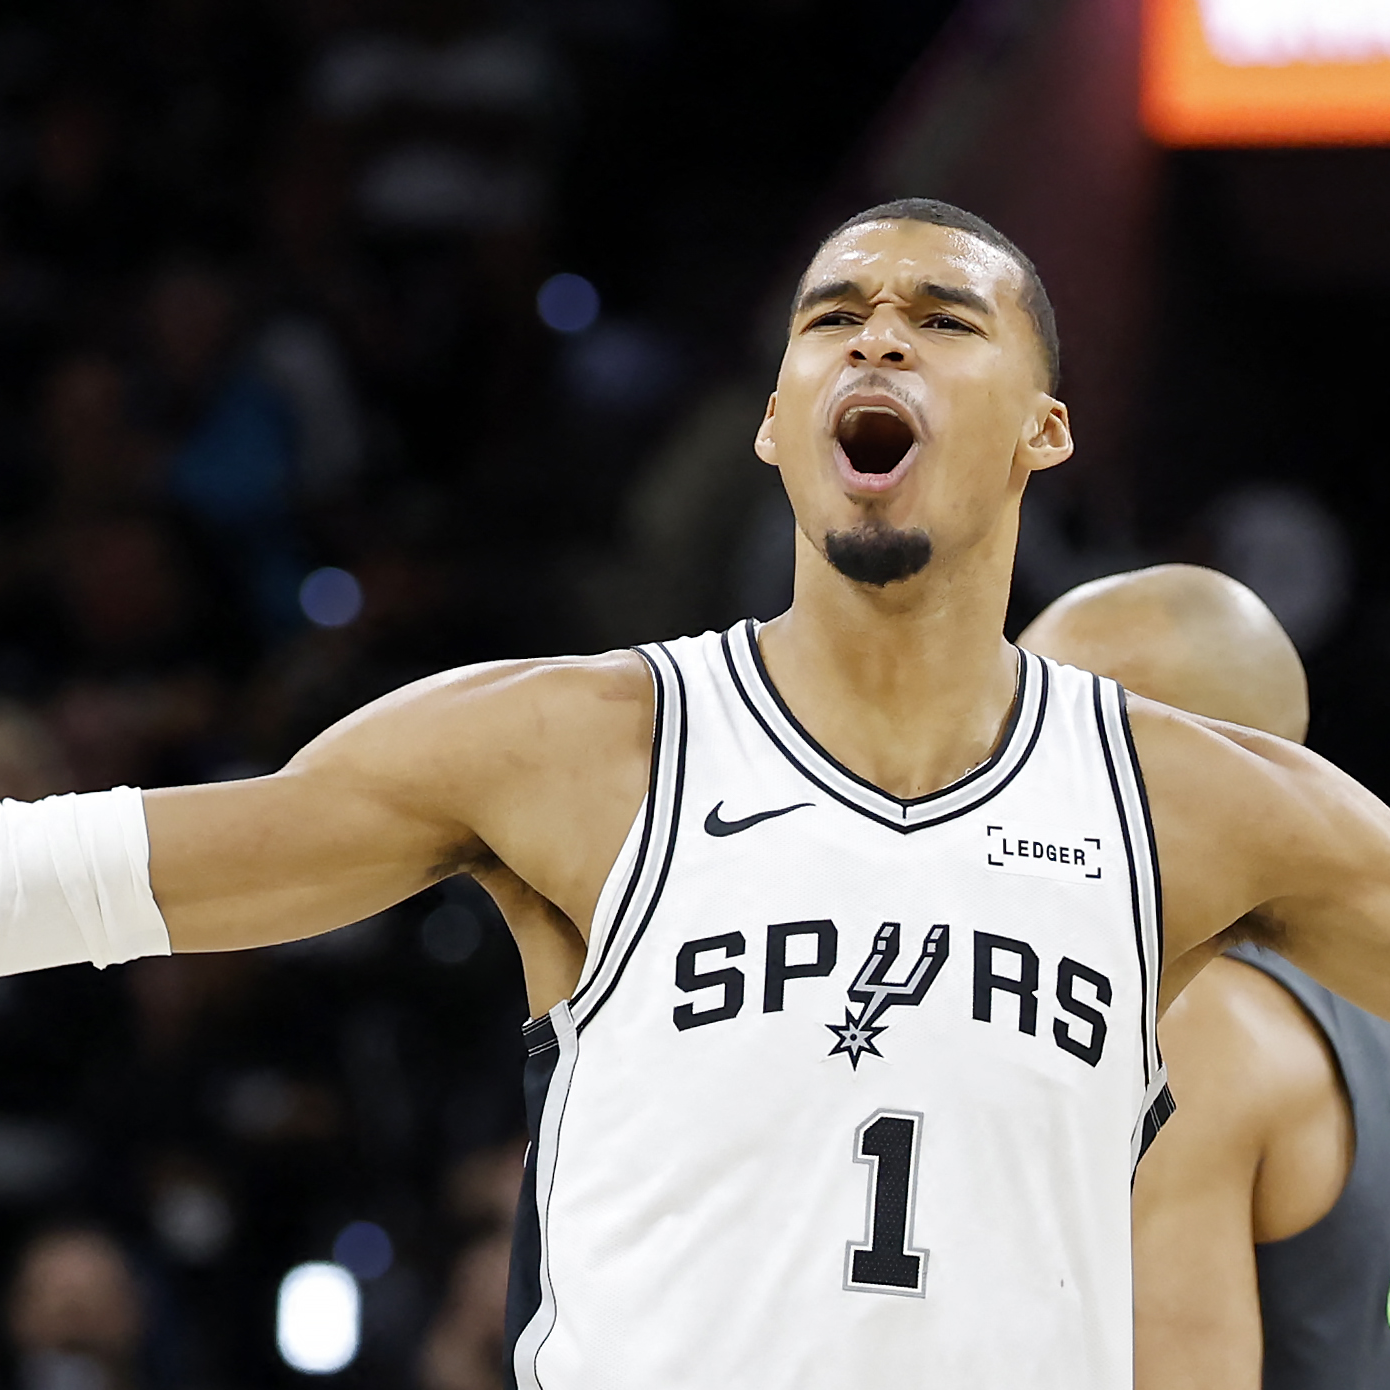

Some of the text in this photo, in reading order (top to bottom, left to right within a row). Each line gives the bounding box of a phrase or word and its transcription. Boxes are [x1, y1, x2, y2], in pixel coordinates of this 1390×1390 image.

[1002, 838, 1086, 866] LEDGER
[672, 918, 1113, 1071] SPURS
[842, 1108, 930, 1298] 1
